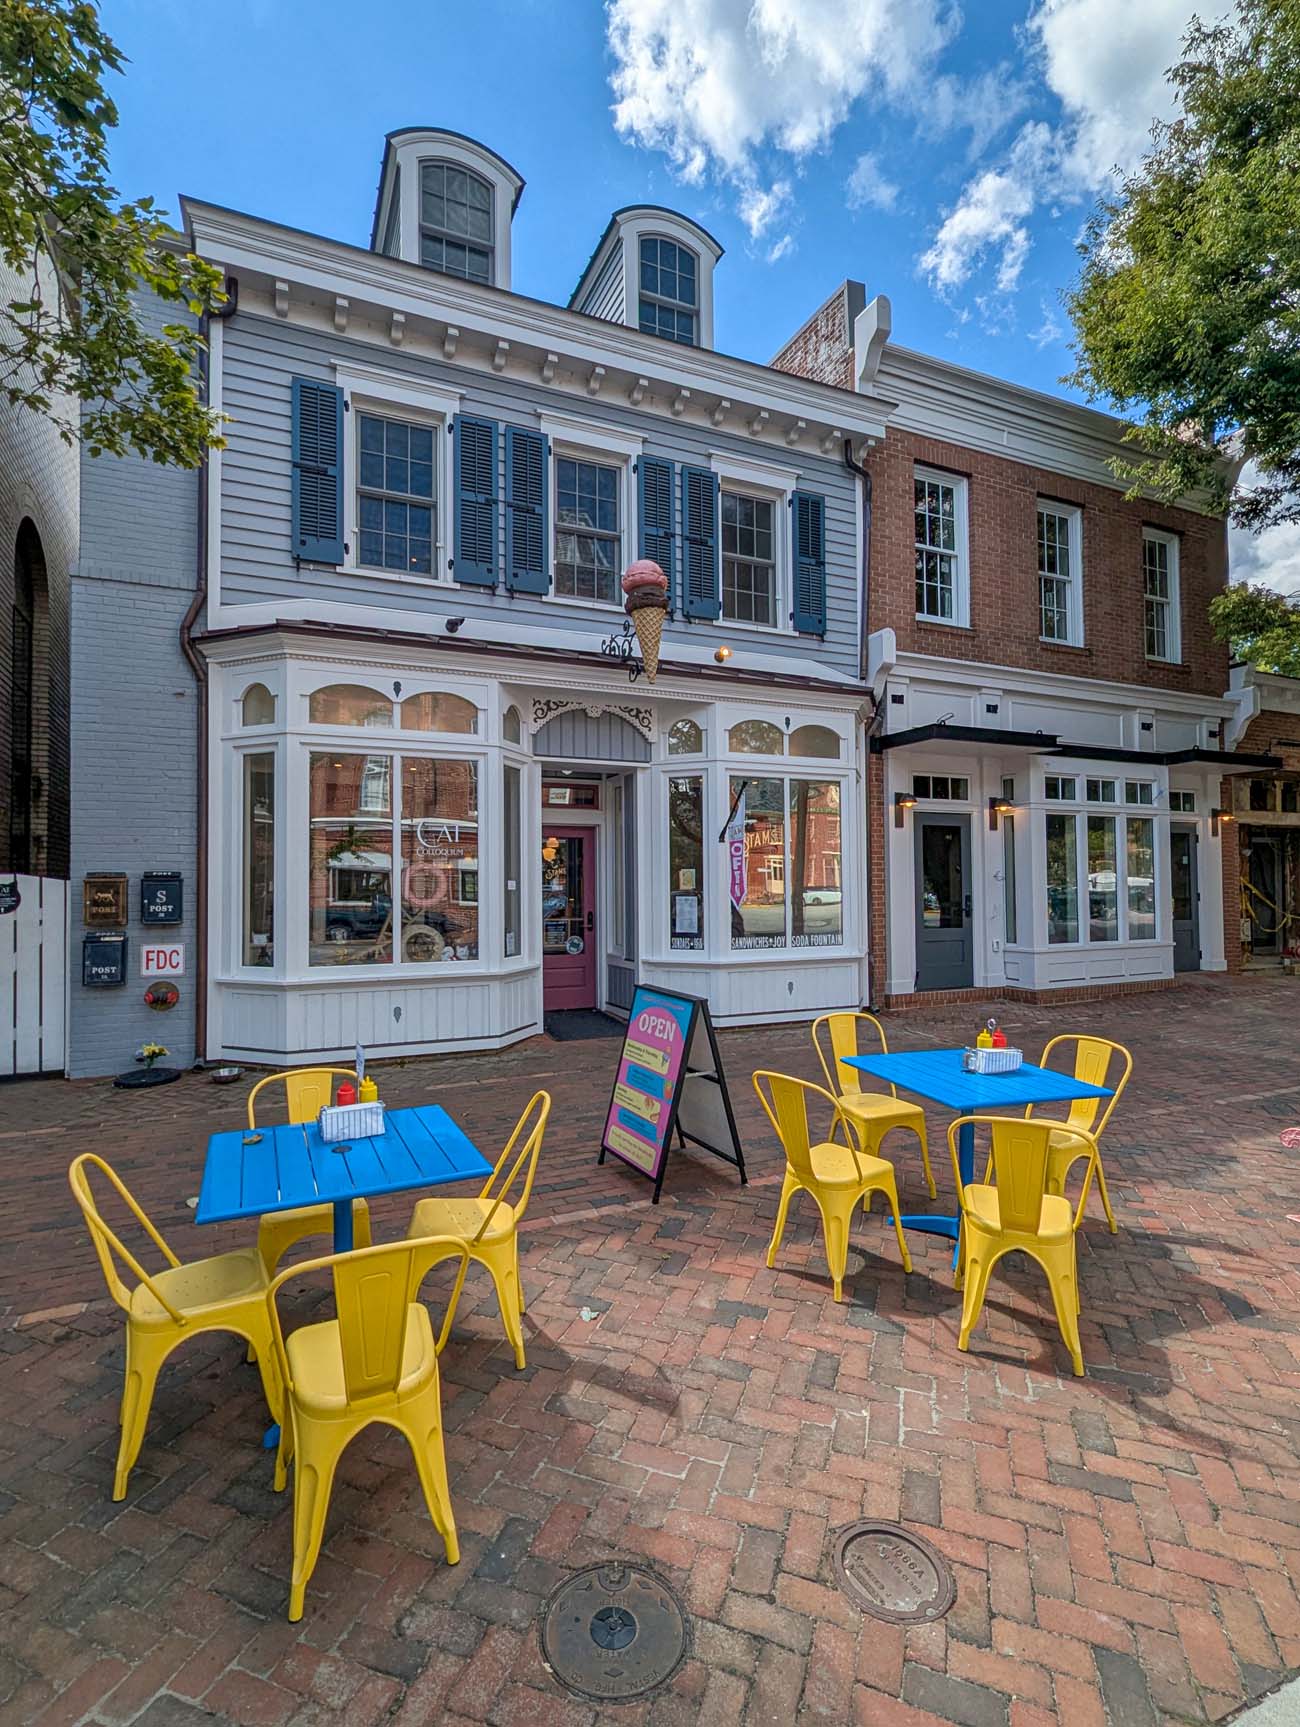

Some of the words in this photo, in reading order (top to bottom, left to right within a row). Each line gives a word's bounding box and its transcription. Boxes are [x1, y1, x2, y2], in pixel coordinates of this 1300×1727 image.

[155, 890, 167, 903] S
[731, 936, 769, 949] SANDWICHES
[772, 935, 786, 948] JOY
[791, 935, 809, 947] SODA
[810, 933, 843, 946] FOUNTAIN
[145, 949, 180, 970] FDC
[638, 1013, 677, 1042] OPEN
